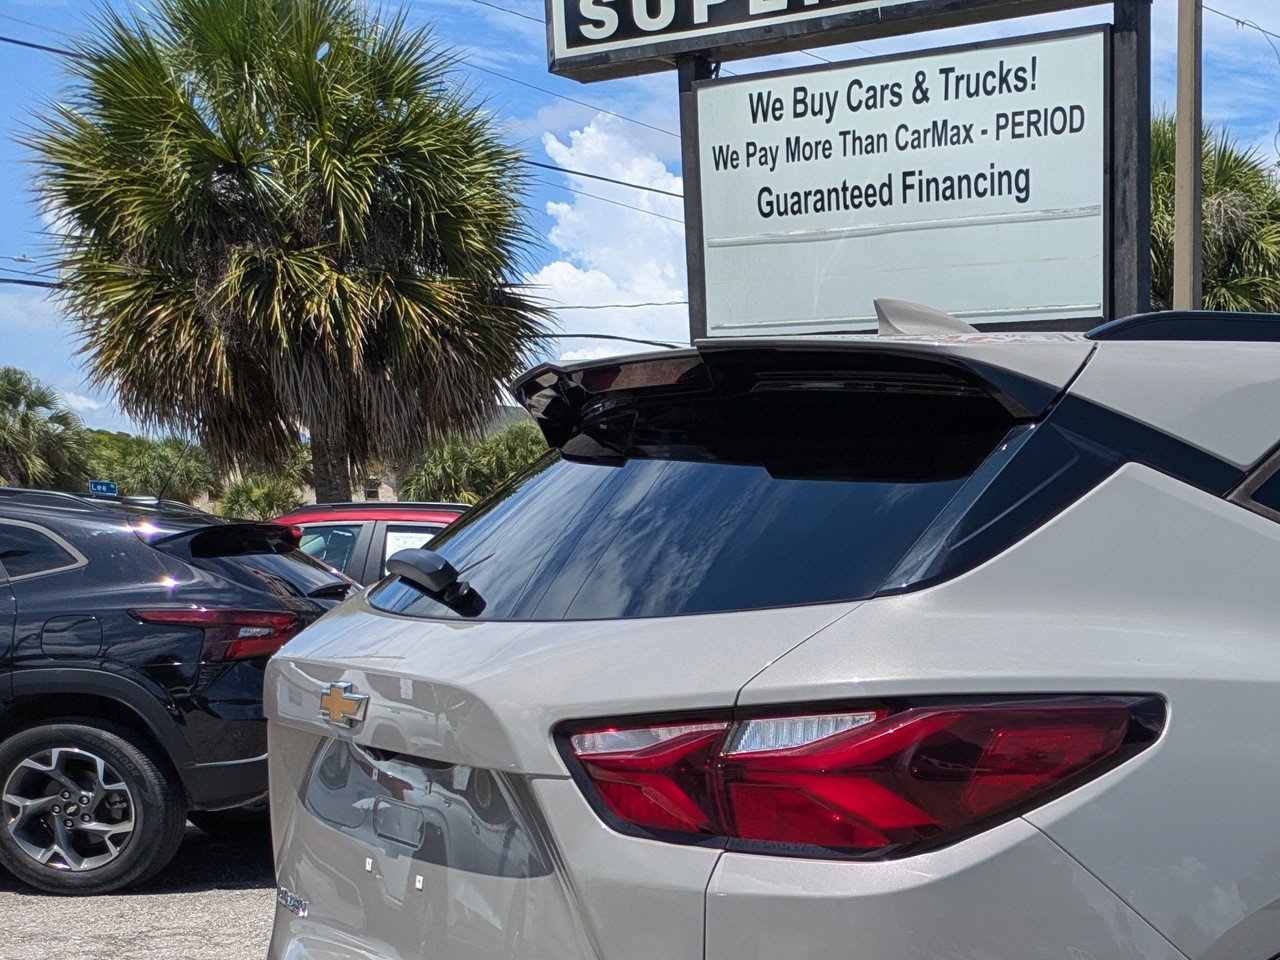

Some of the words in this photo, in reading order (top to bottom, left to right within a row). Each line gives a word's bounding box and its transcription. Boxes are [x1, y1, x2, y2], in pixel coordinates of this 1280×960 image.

[748, 90, 784, 124] We
[792, 86, 839, 125] Buy
[846, 78, 903, 113] Cars
[911, 71, 931, 105] &
[938, 57, 1037, 101] Trucks!
[711, 144, 740, 171] We
[745, 141, 780, 173] Pay
[785, 135, 833, 163] More
[838, 129, 888, 157] Than
[895, 119, 974, 151] CarMax
[995, 104, 1085, 141] PERIOD
[757, 173, 893, 219] Guaranteed
[902, 162, 1030, 204] Financing
